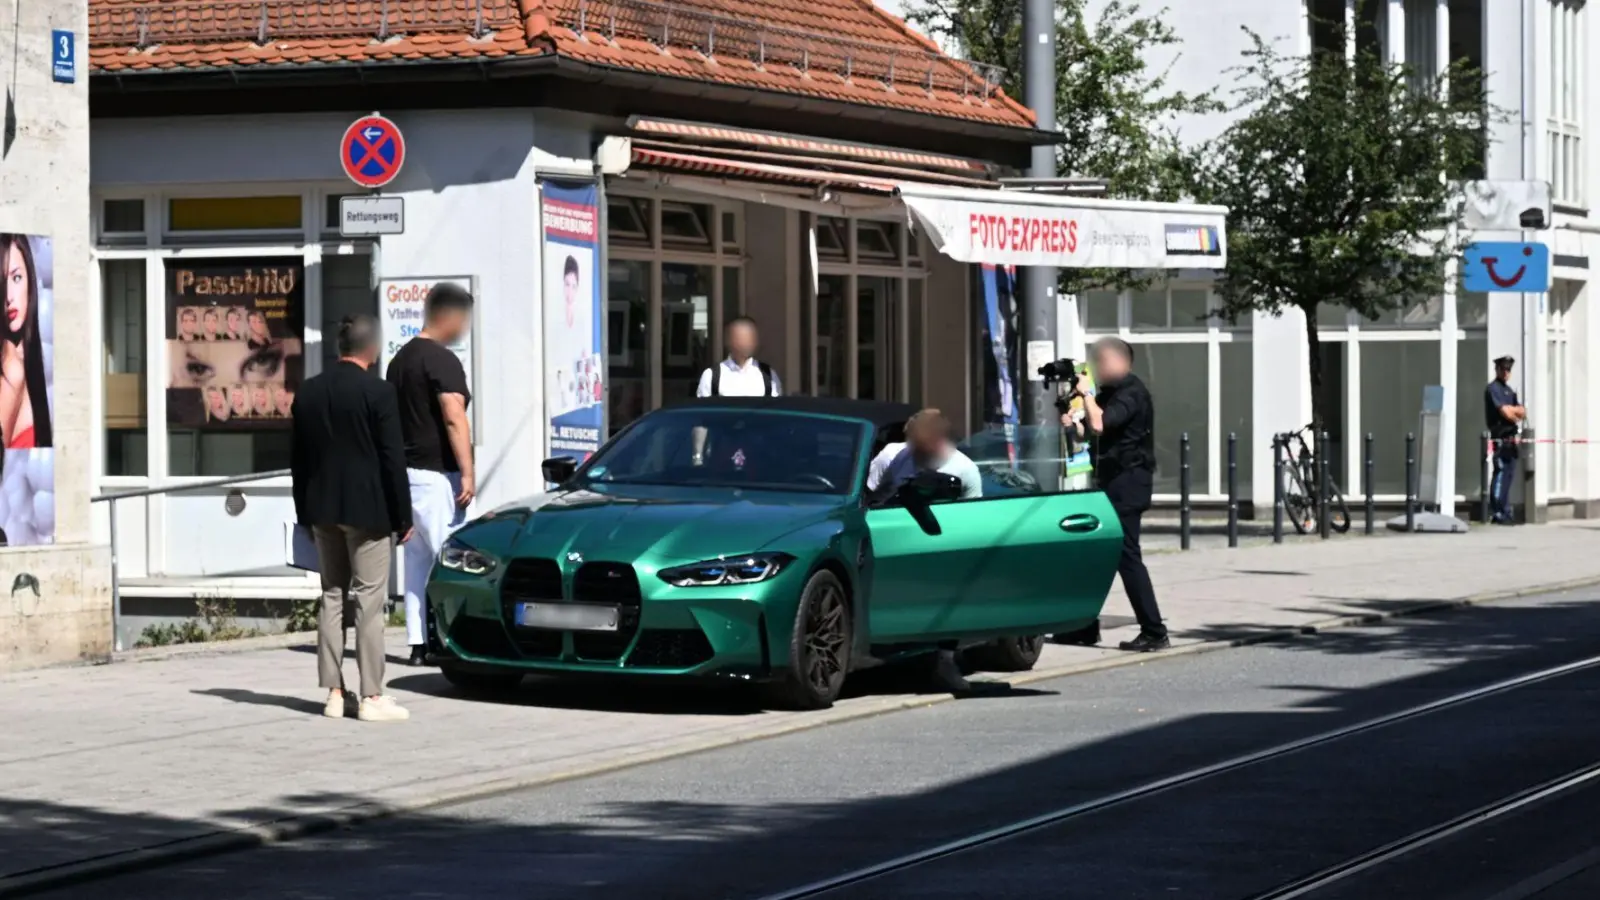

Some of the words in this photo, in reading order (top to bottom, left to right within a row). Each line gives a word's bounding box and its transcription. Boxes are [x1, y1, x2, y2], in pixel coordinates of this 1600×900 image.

[60, 35, 69, 58] 3
[346, 211, 399, 224] Rettungsweg
[969, 213, 1078, 253] FOTO-EXPRESS
[176, 268, 296, 295] Passbild
[386, 283, 432, 302] Großd
